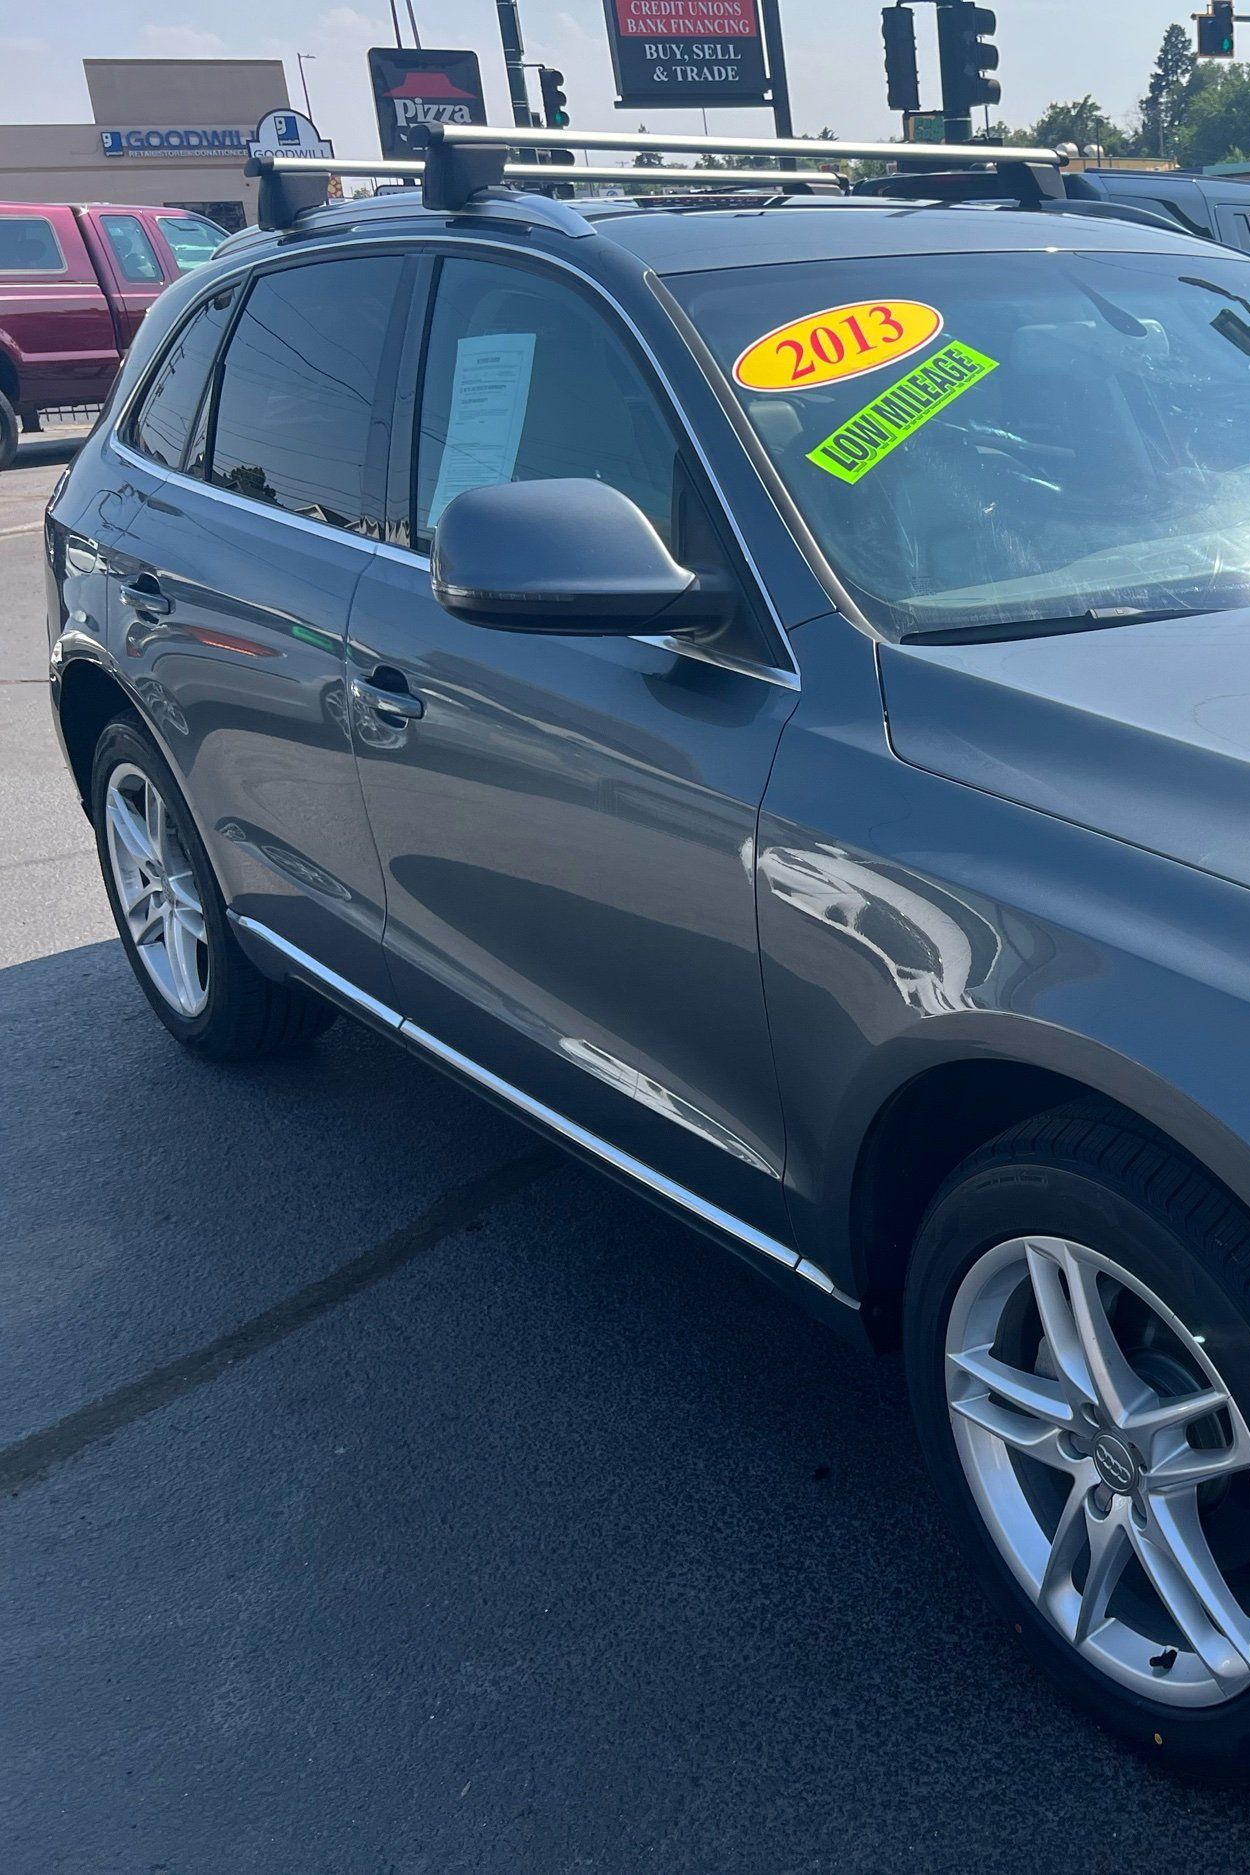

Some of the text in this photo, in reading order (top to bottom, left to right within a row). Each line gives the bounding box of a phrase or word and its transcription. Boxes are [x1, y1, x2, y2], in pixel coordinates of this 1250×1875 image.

[630, 1, 742, 16] CREDIT UNIONS
[627, 19, 750, 34] BANK FINANCING
[644, 44, 741, 62] BUY, SELL
[653, 66, 739, 82] & TRADE
[393, 97, 472, 126] Pizza
[254, 149, 330, 159] GOODWILL
[776, 306, 904, 381] 2013
[820, 348, 984, 473] LOW MILEAGE
